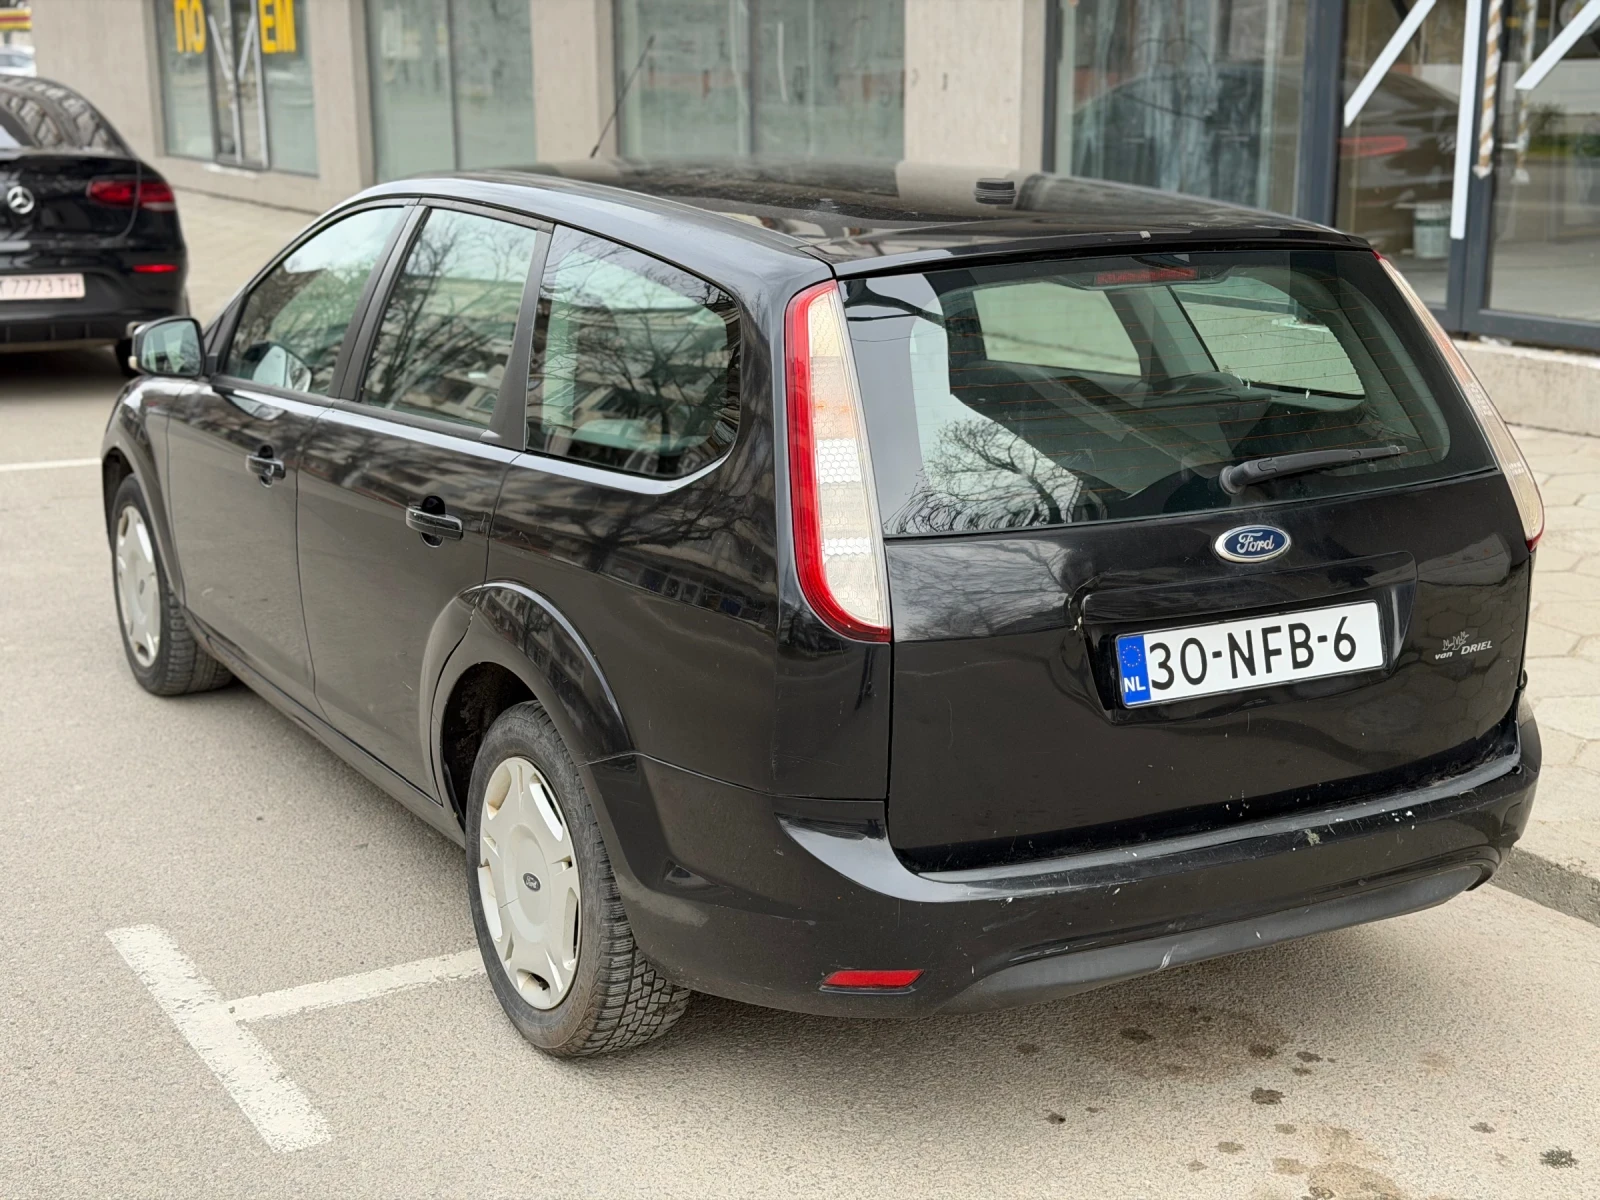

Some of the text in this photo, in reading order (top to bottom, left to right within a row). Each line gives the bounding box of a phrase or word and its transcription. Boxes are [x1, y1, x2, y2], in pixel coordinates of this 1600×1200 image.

[11, 277, 53, 295] 7773
[1236, 531, 1275, 554] Ford
[1150, 616, 1357, 690] 30-NFB-6
[1434, 640, 1493, 660] van DRIEL
[1123, 675, 1146, 693] NL
